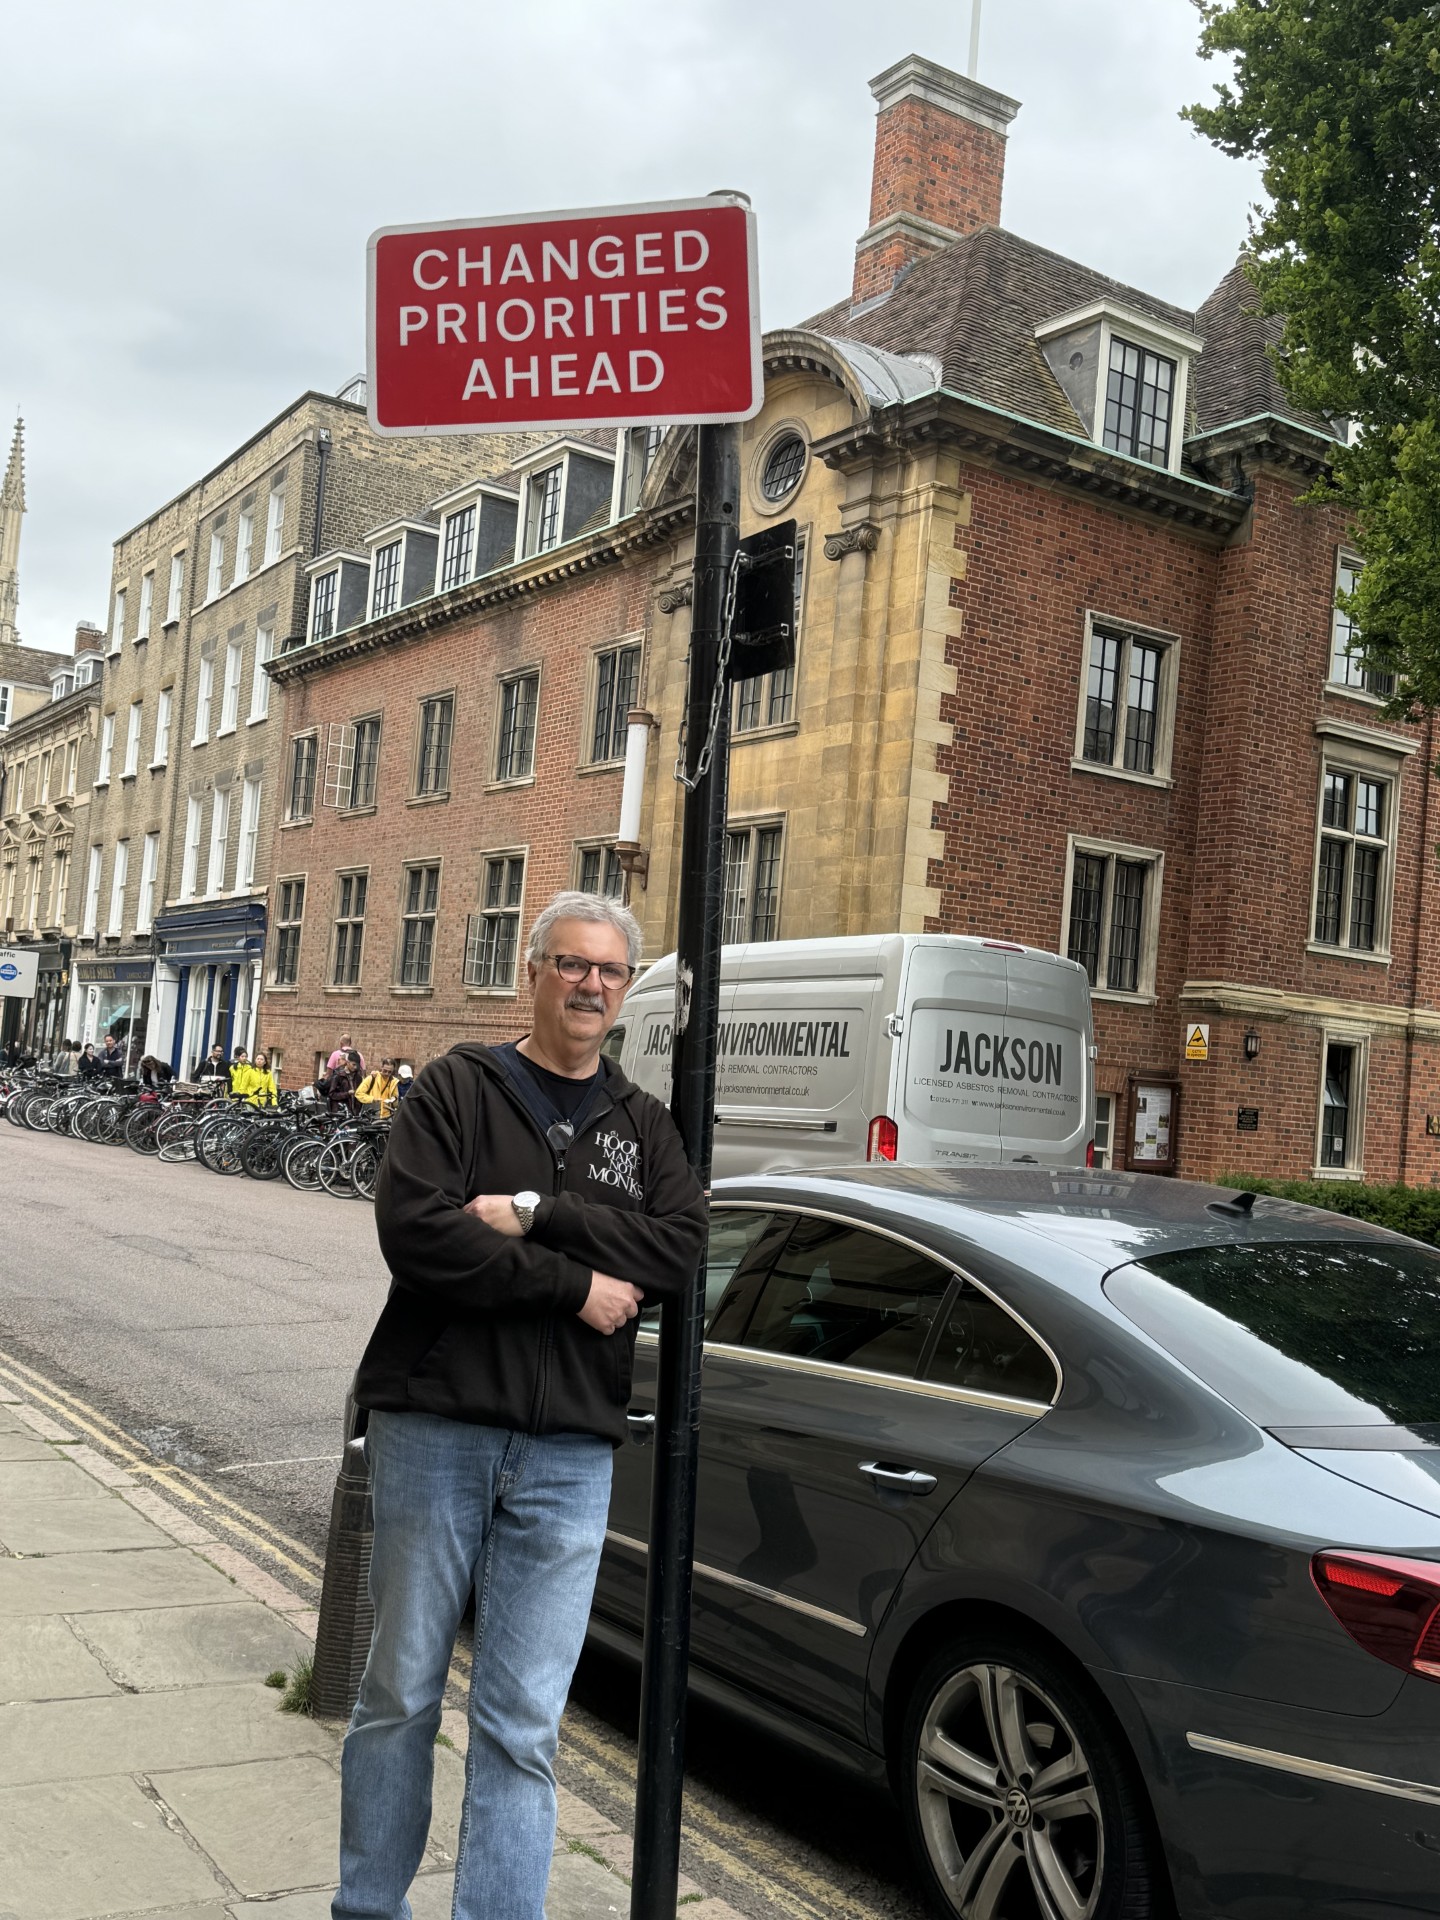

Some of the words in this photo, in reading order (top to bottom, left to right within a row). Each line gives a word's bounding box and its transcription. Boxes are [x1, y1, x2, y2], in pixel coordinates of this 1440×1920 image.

[413, 230, 709, 291] CHANGED
[400, 286, 728, 346] PRIORITIES
[461, 350, 665, 400] AHEAD
[717, 1021, 850, 1057] NVIRONMENTAL
[728, 1063, 760, 1074] REMOVAL
[762, 1064, 818, 1076] CONTRACTORS
[939, 1029, 1062, 1086] JACKSON
[914, 1077, 953, 1088] LICENSED
[956, 1081, 995, 1093] ASBESTOS
[998, 1086, 1029, 1097] REMOVAL
[1032, 1090, 1079, 1103] CONTRACTORS
[609, 1159, 635, 1176] NOT
[935, 1150, 979, 1159] TRANSIT
[587, 1163, 644, 1200] MONKS
